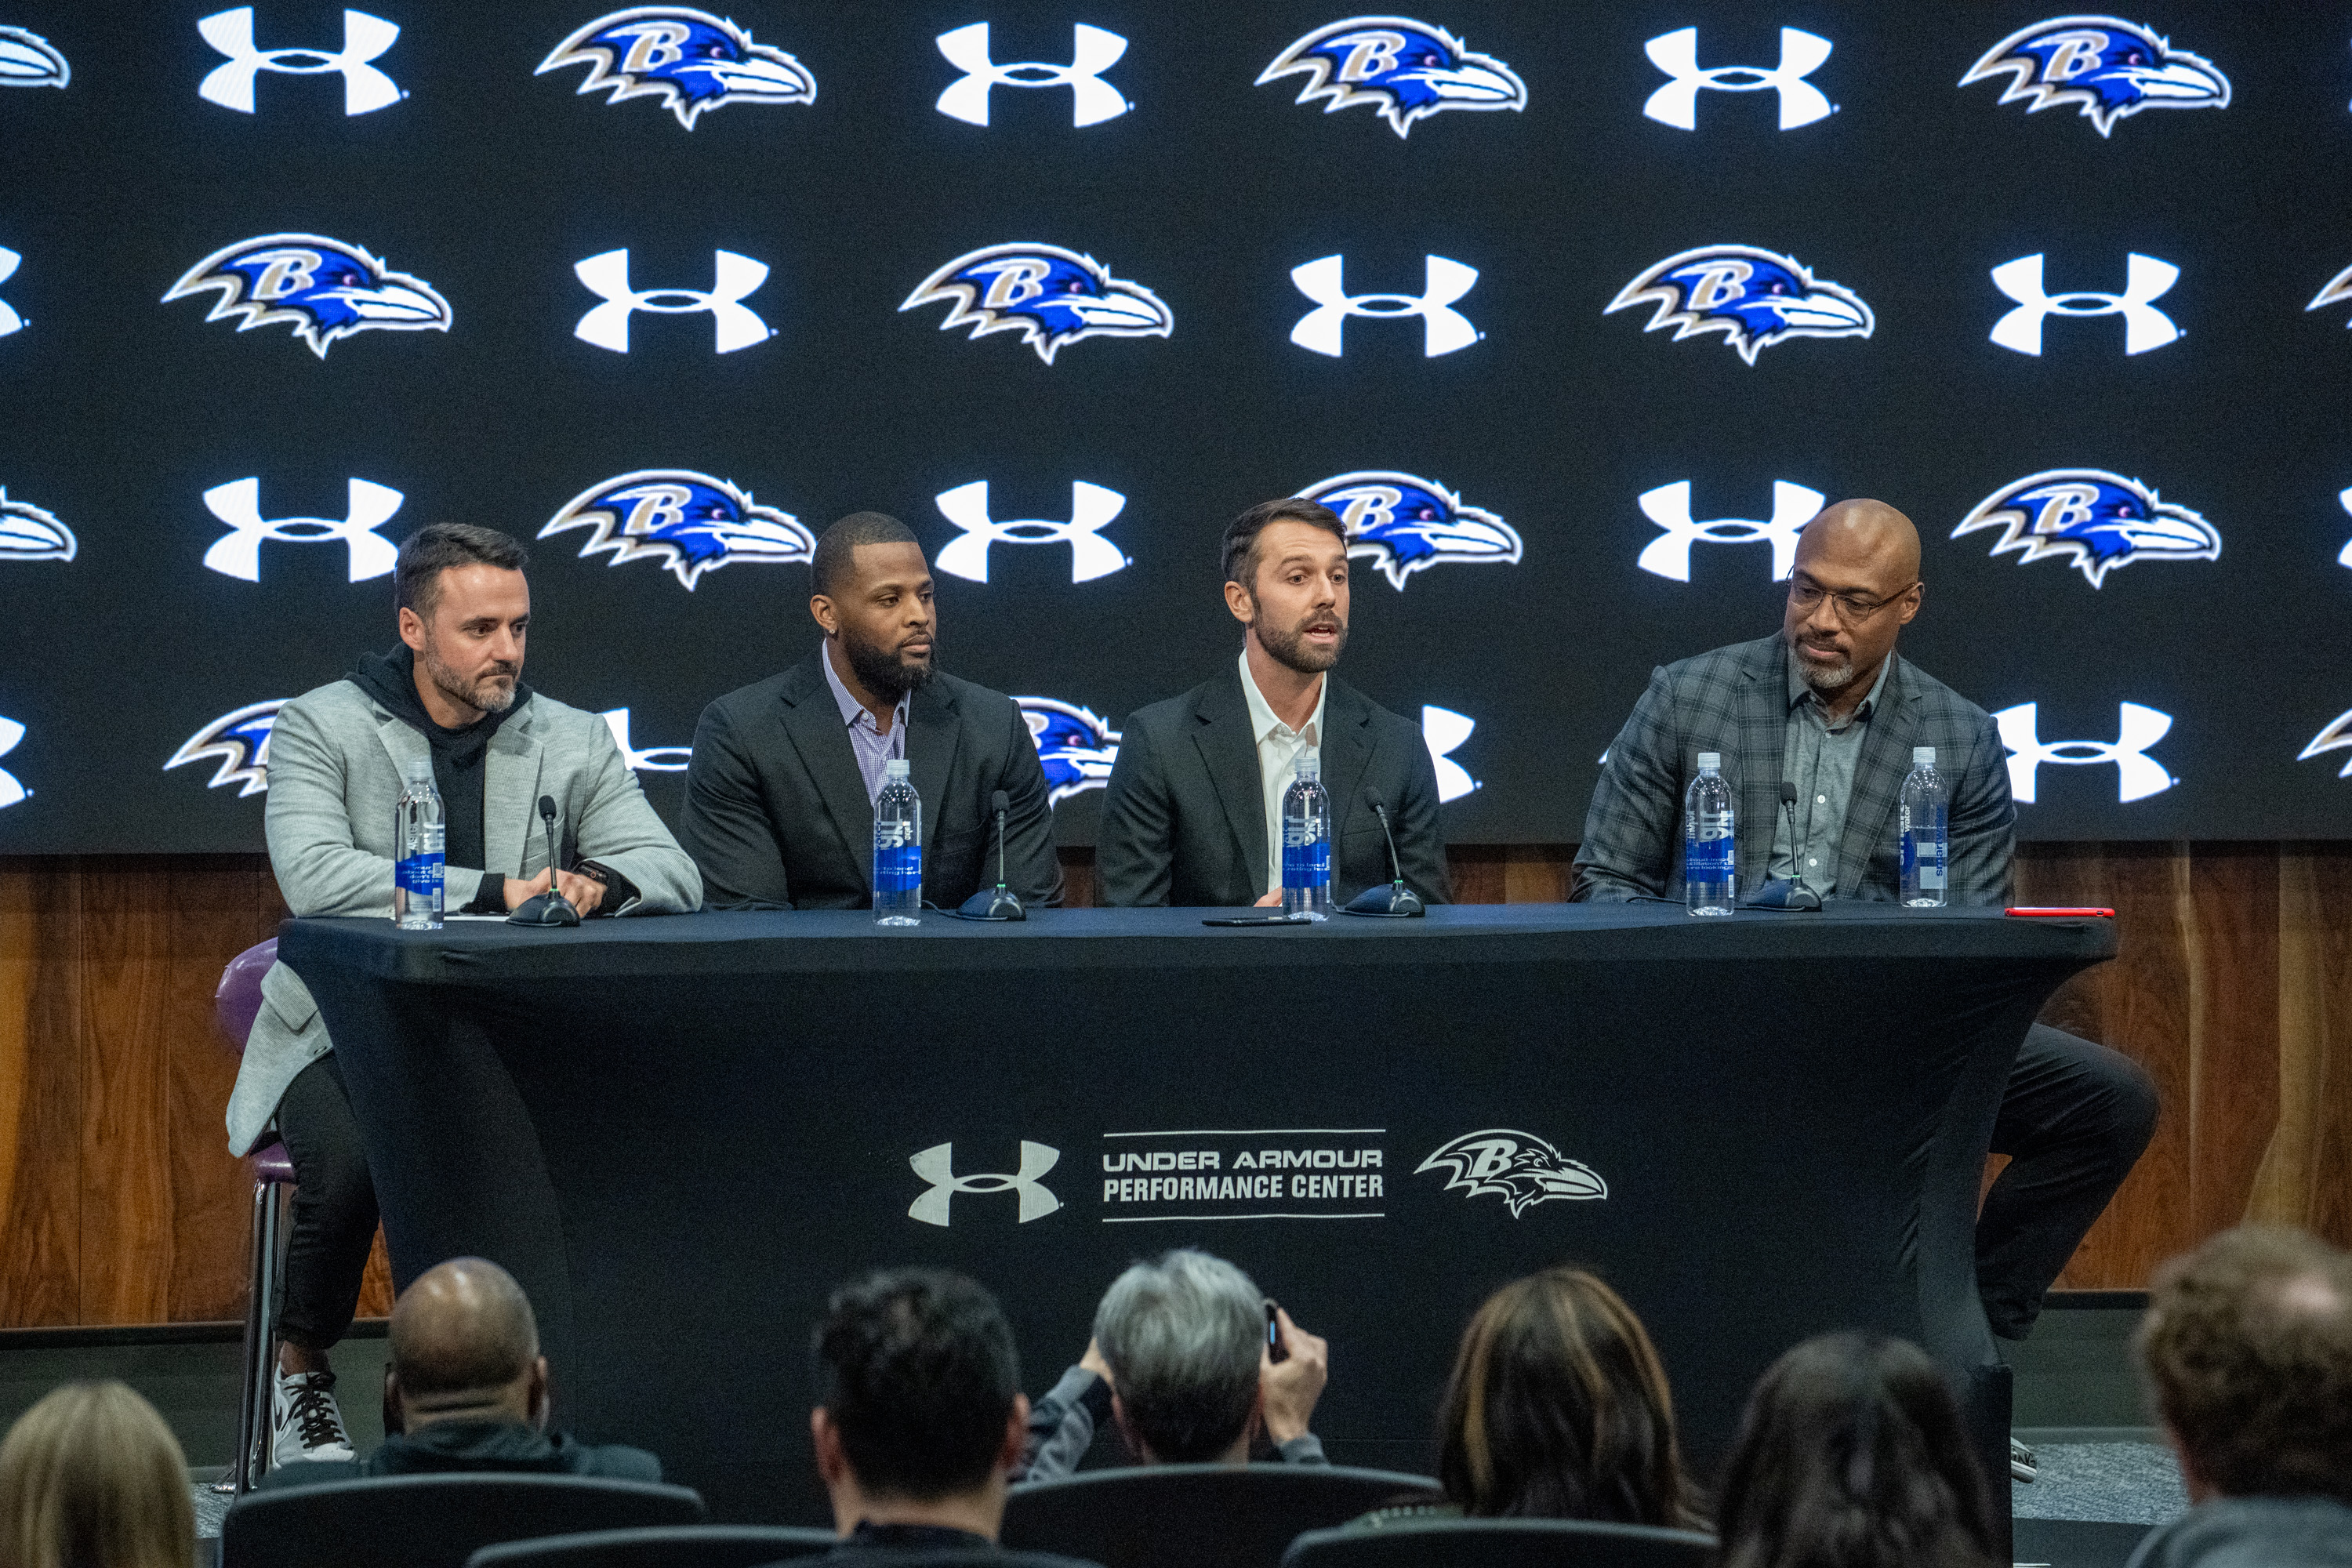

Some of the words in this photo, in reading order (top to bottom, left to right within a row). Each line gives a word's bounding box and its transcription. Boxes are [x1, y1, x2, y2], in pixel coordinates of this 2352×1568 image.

[605, 21, 691, 73] B
[1323, 30, 1406, 82] B
[2028, 31, 2109, 82] B
[233, 249, 321, 300] B
[967, 258, 1050, 309] B
[1671, 260, 1753, 310] B
[607, 485, 691, 535] B
[1316, 485, 1402, 535] B
[2020, 484, 2099, 535] B
[1102, 1151, 1221, 1172] UNDER
[1232, 1149, 1383, 1170] ARMOUR
[1458, 1139, 1517, 1178] B
[1103, 1175, 1283, 1202] PERFORMANCE
[1291, 1174, 1384, 1198] CENTER
